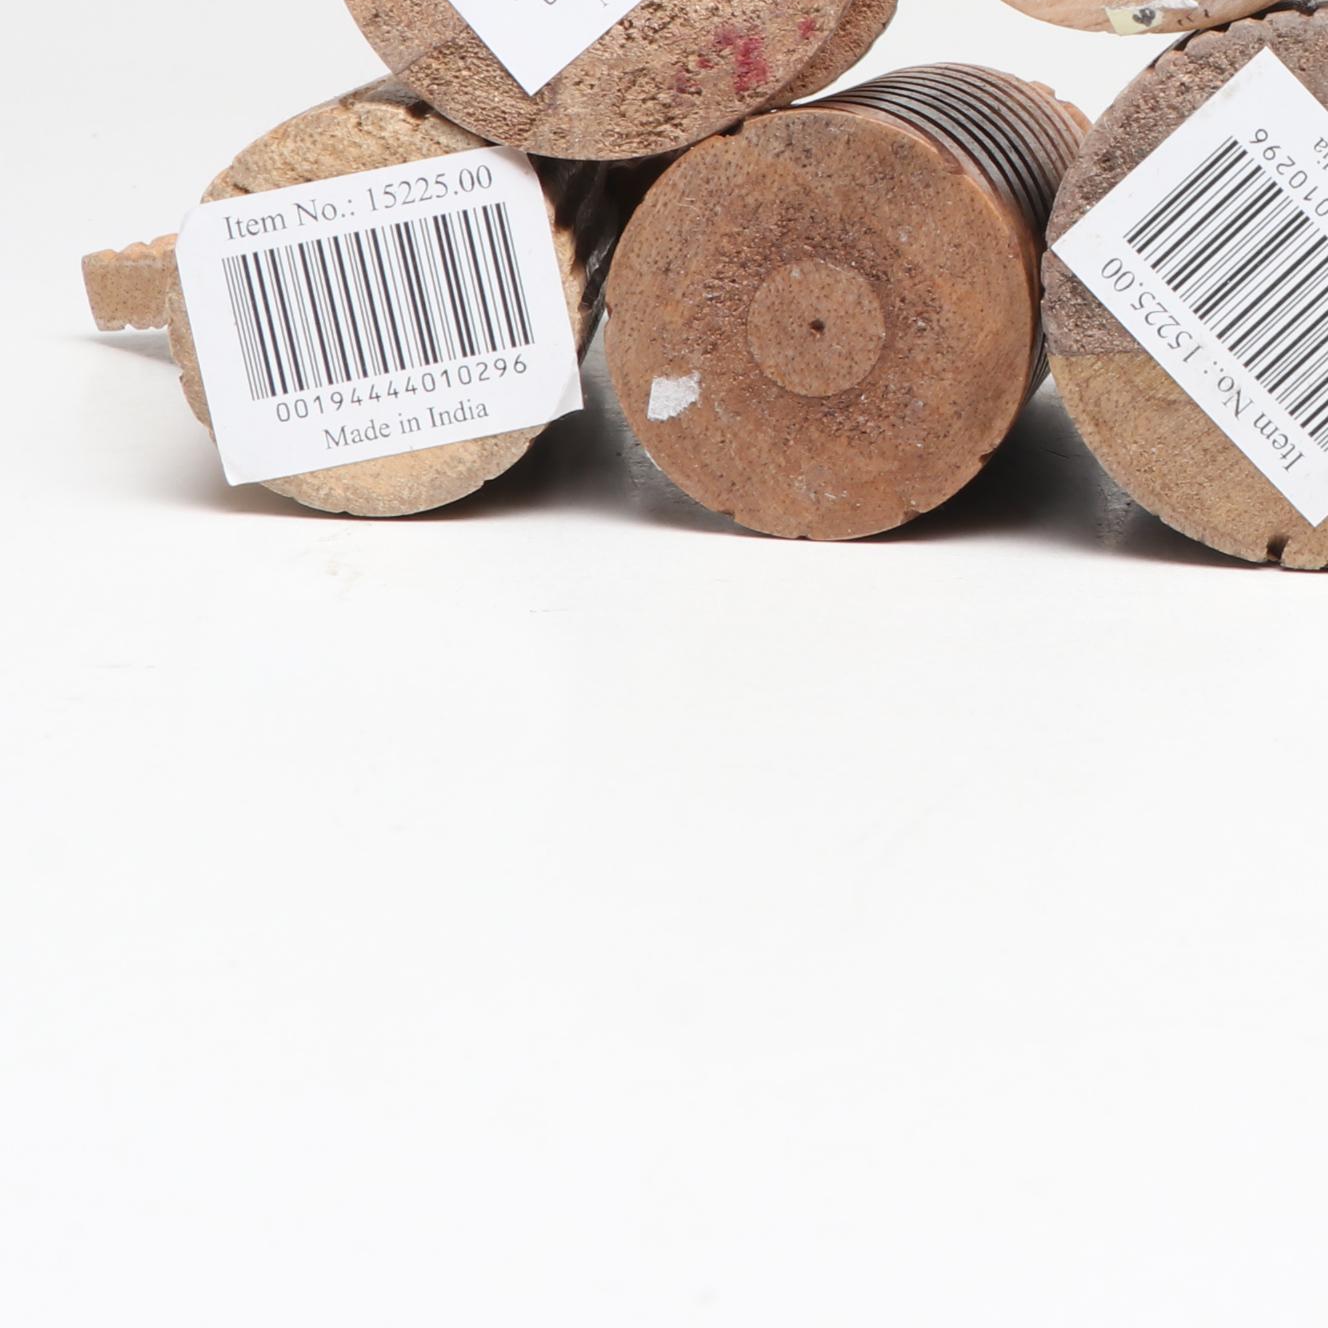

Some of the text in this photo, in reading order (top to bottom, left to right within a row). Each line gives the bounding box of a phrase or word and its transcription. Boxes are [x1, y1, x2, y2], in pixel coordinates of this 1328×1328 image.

[224, 164, 493, 240] Item No.: 15225.00
[276, 353, 528, 423] 00194444010296
[1101, 257, 1305, 472] Item No.: 15225.00
[323, 398, 489, 450] Made in India
